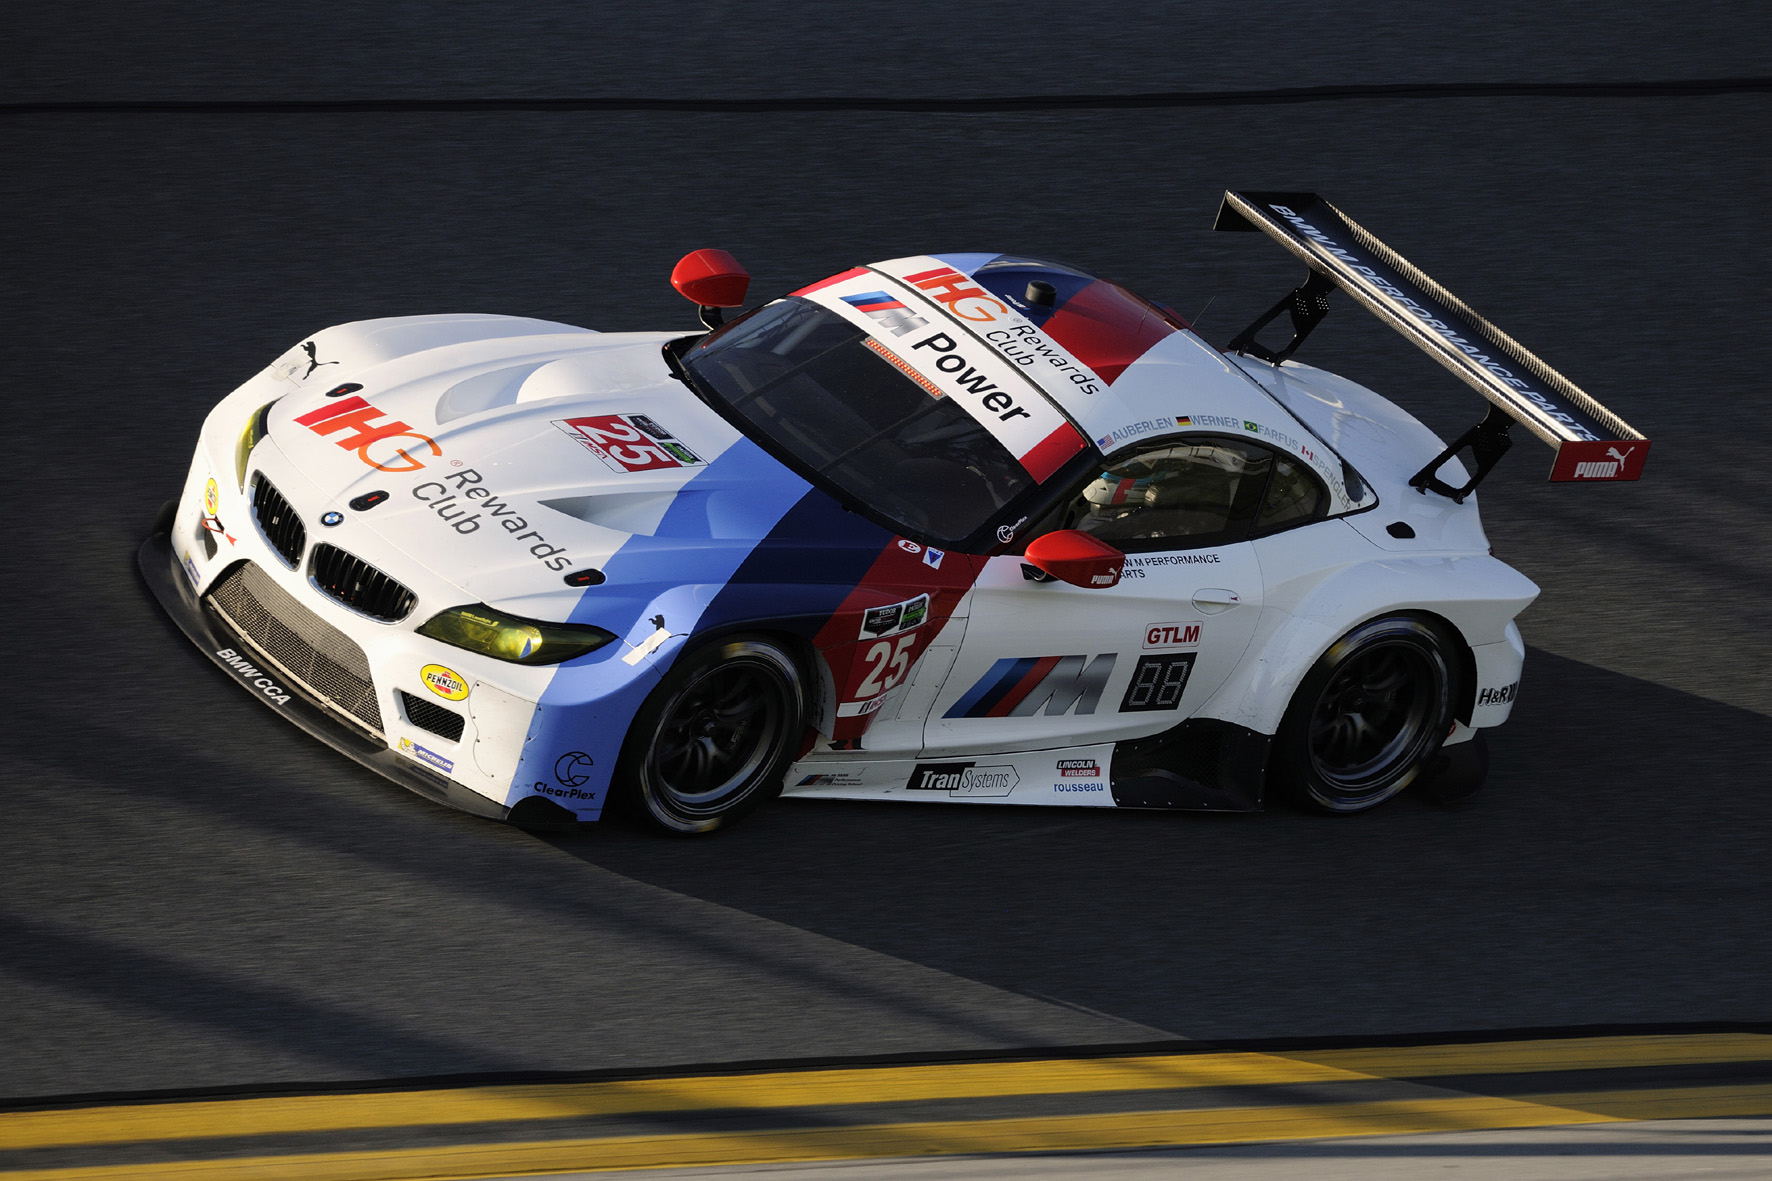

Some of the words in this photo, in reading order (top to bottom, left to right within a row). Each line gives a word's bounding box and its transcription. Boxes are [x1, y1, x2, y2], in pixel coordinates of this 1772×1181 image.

[902, 267, 1008, 322] IHG
[1268, 203, 1336, 248] BMW
[1329, 245, 1360, 265] M
[1349, 264, 1529, 389] PERFORMANCE
[986, 330, 1035, 366] Club
[1009, 323, 1100, 396] Rewards
[911, 332, 1031, 422] Power
[293, 396, 442, 473] IHG
[576, 422, 672, 466] 25
[1112, 416, 1173, 442] AUBERLEN
[1189, 414, 1240, 430] WERNER
[1258, 424, 1299, 451] FARFUS
[1312, 454, 1351, 511] SPENGLER
[1574, 462, 1618, 478] PUMA
[412, 481, 481, 535] Club
[445, 468, 573, 572] Rewards
[1134, 557, 1145, 568] M
[1144, 554, 1221, 567] PERFORMANCE
[1091, 575, 1114, 585] PUMA
[1119, 568, 1146, 579] ARTS
[1147, 625, 1200, 645] GTLM
[216, 648, 262, 678] BMW
[253, 676, 292, 705] CCA
[855, 633, 917, 699] 25
[426, 672, 464, 692] PENNZOIL
[1478, 684, 1509, 706] H&R
[417, 749, 453, 769] MICHELIN
[1057, 760, 1095, 769] LINCOLN
[920, 769, 1010, 793] TranSystems
[1064, 769, 1097, 777] WELDERS
[533, 781, 596, 800] ClearPlex
[1054, 782, 1104, 793] rousseau
